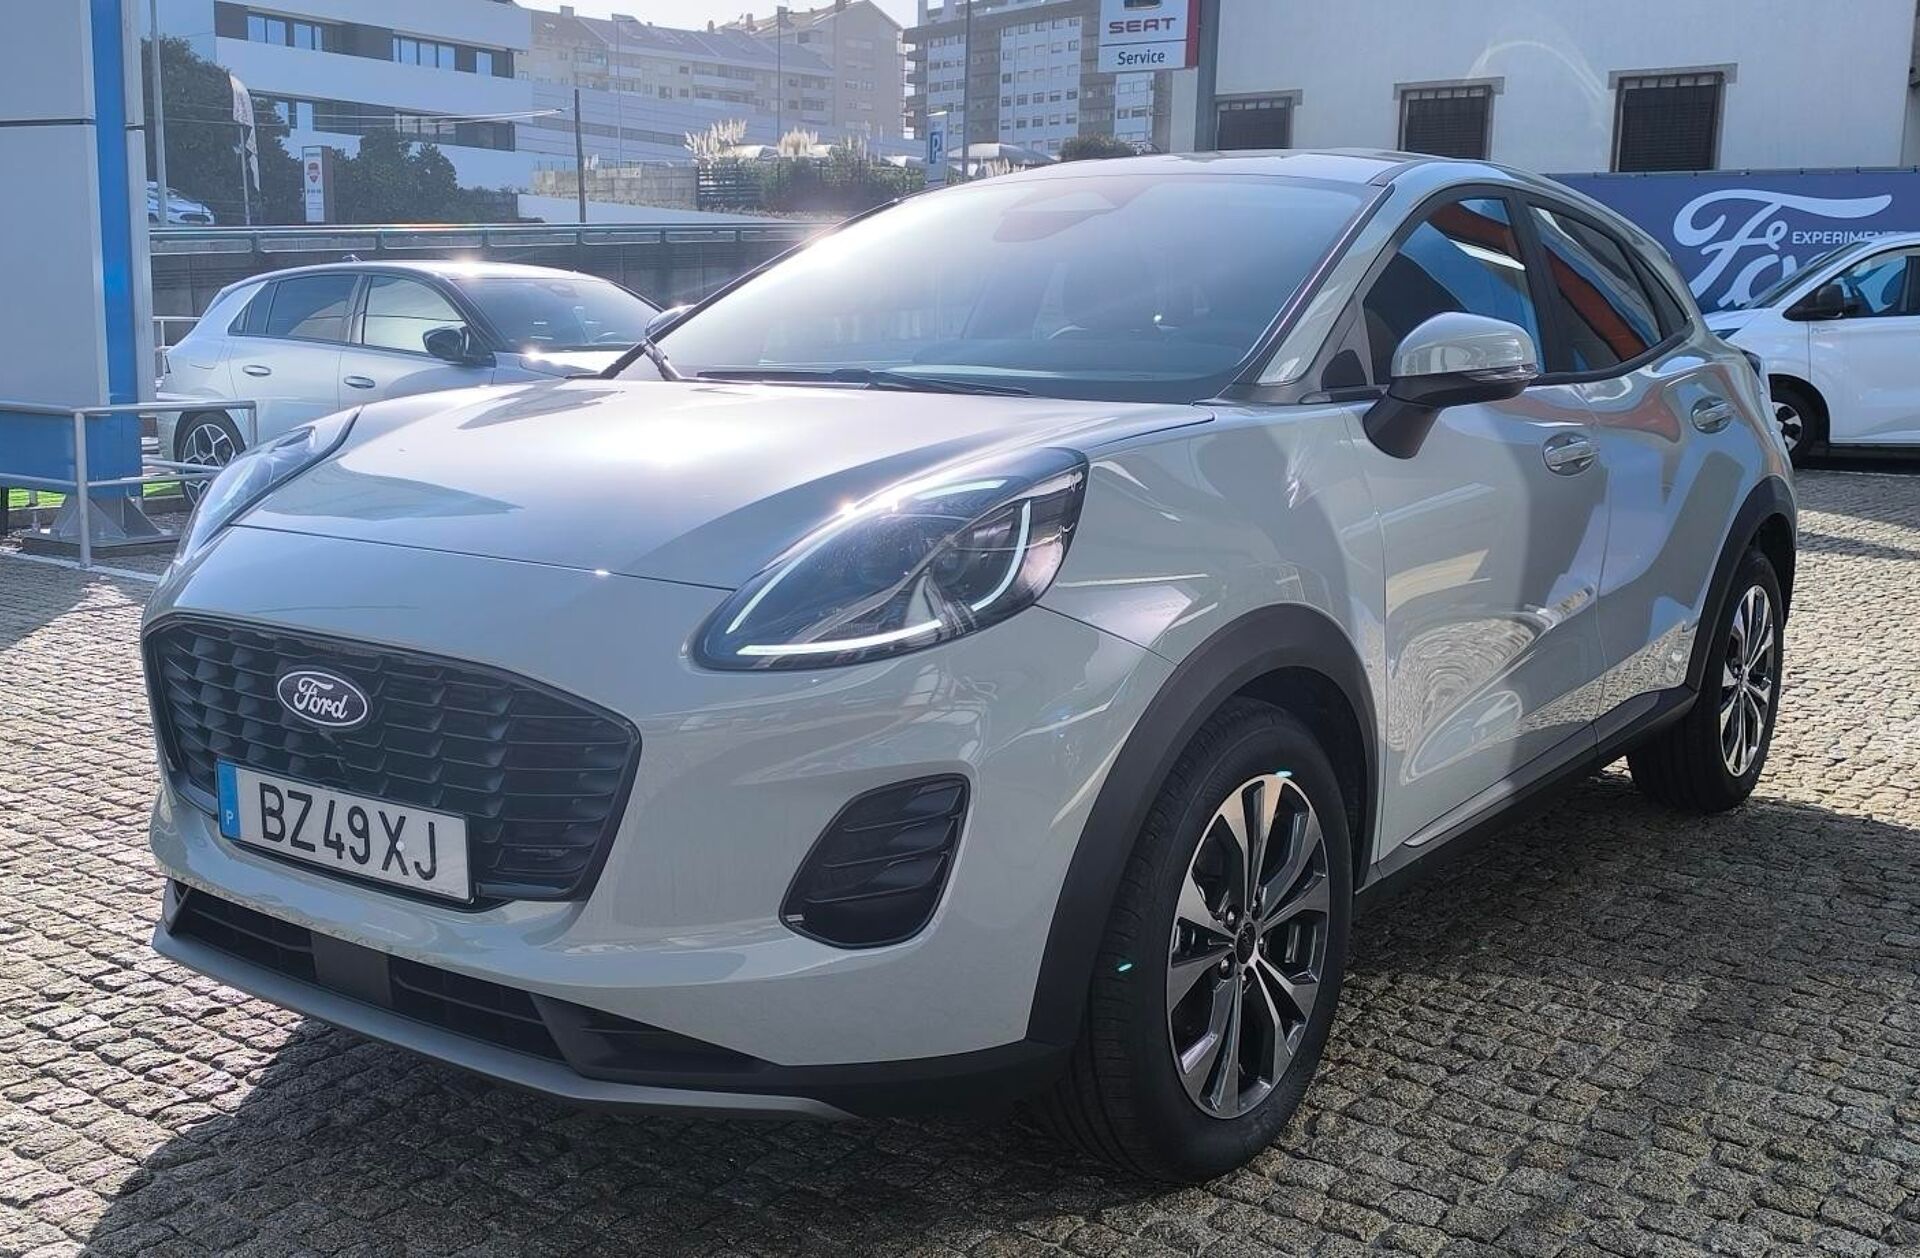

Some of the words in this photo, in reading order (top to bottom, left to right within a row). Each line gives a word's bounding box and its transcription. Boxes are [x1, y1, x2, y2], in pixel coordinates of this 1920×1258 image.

[1109, 17, 1176, 34] SEAT
[1117, 49, 1165, 65] Service
[929, 131, 944, 164] P
[293, 677, 348, 719] Ford
[225, 810, 234, 825] P
